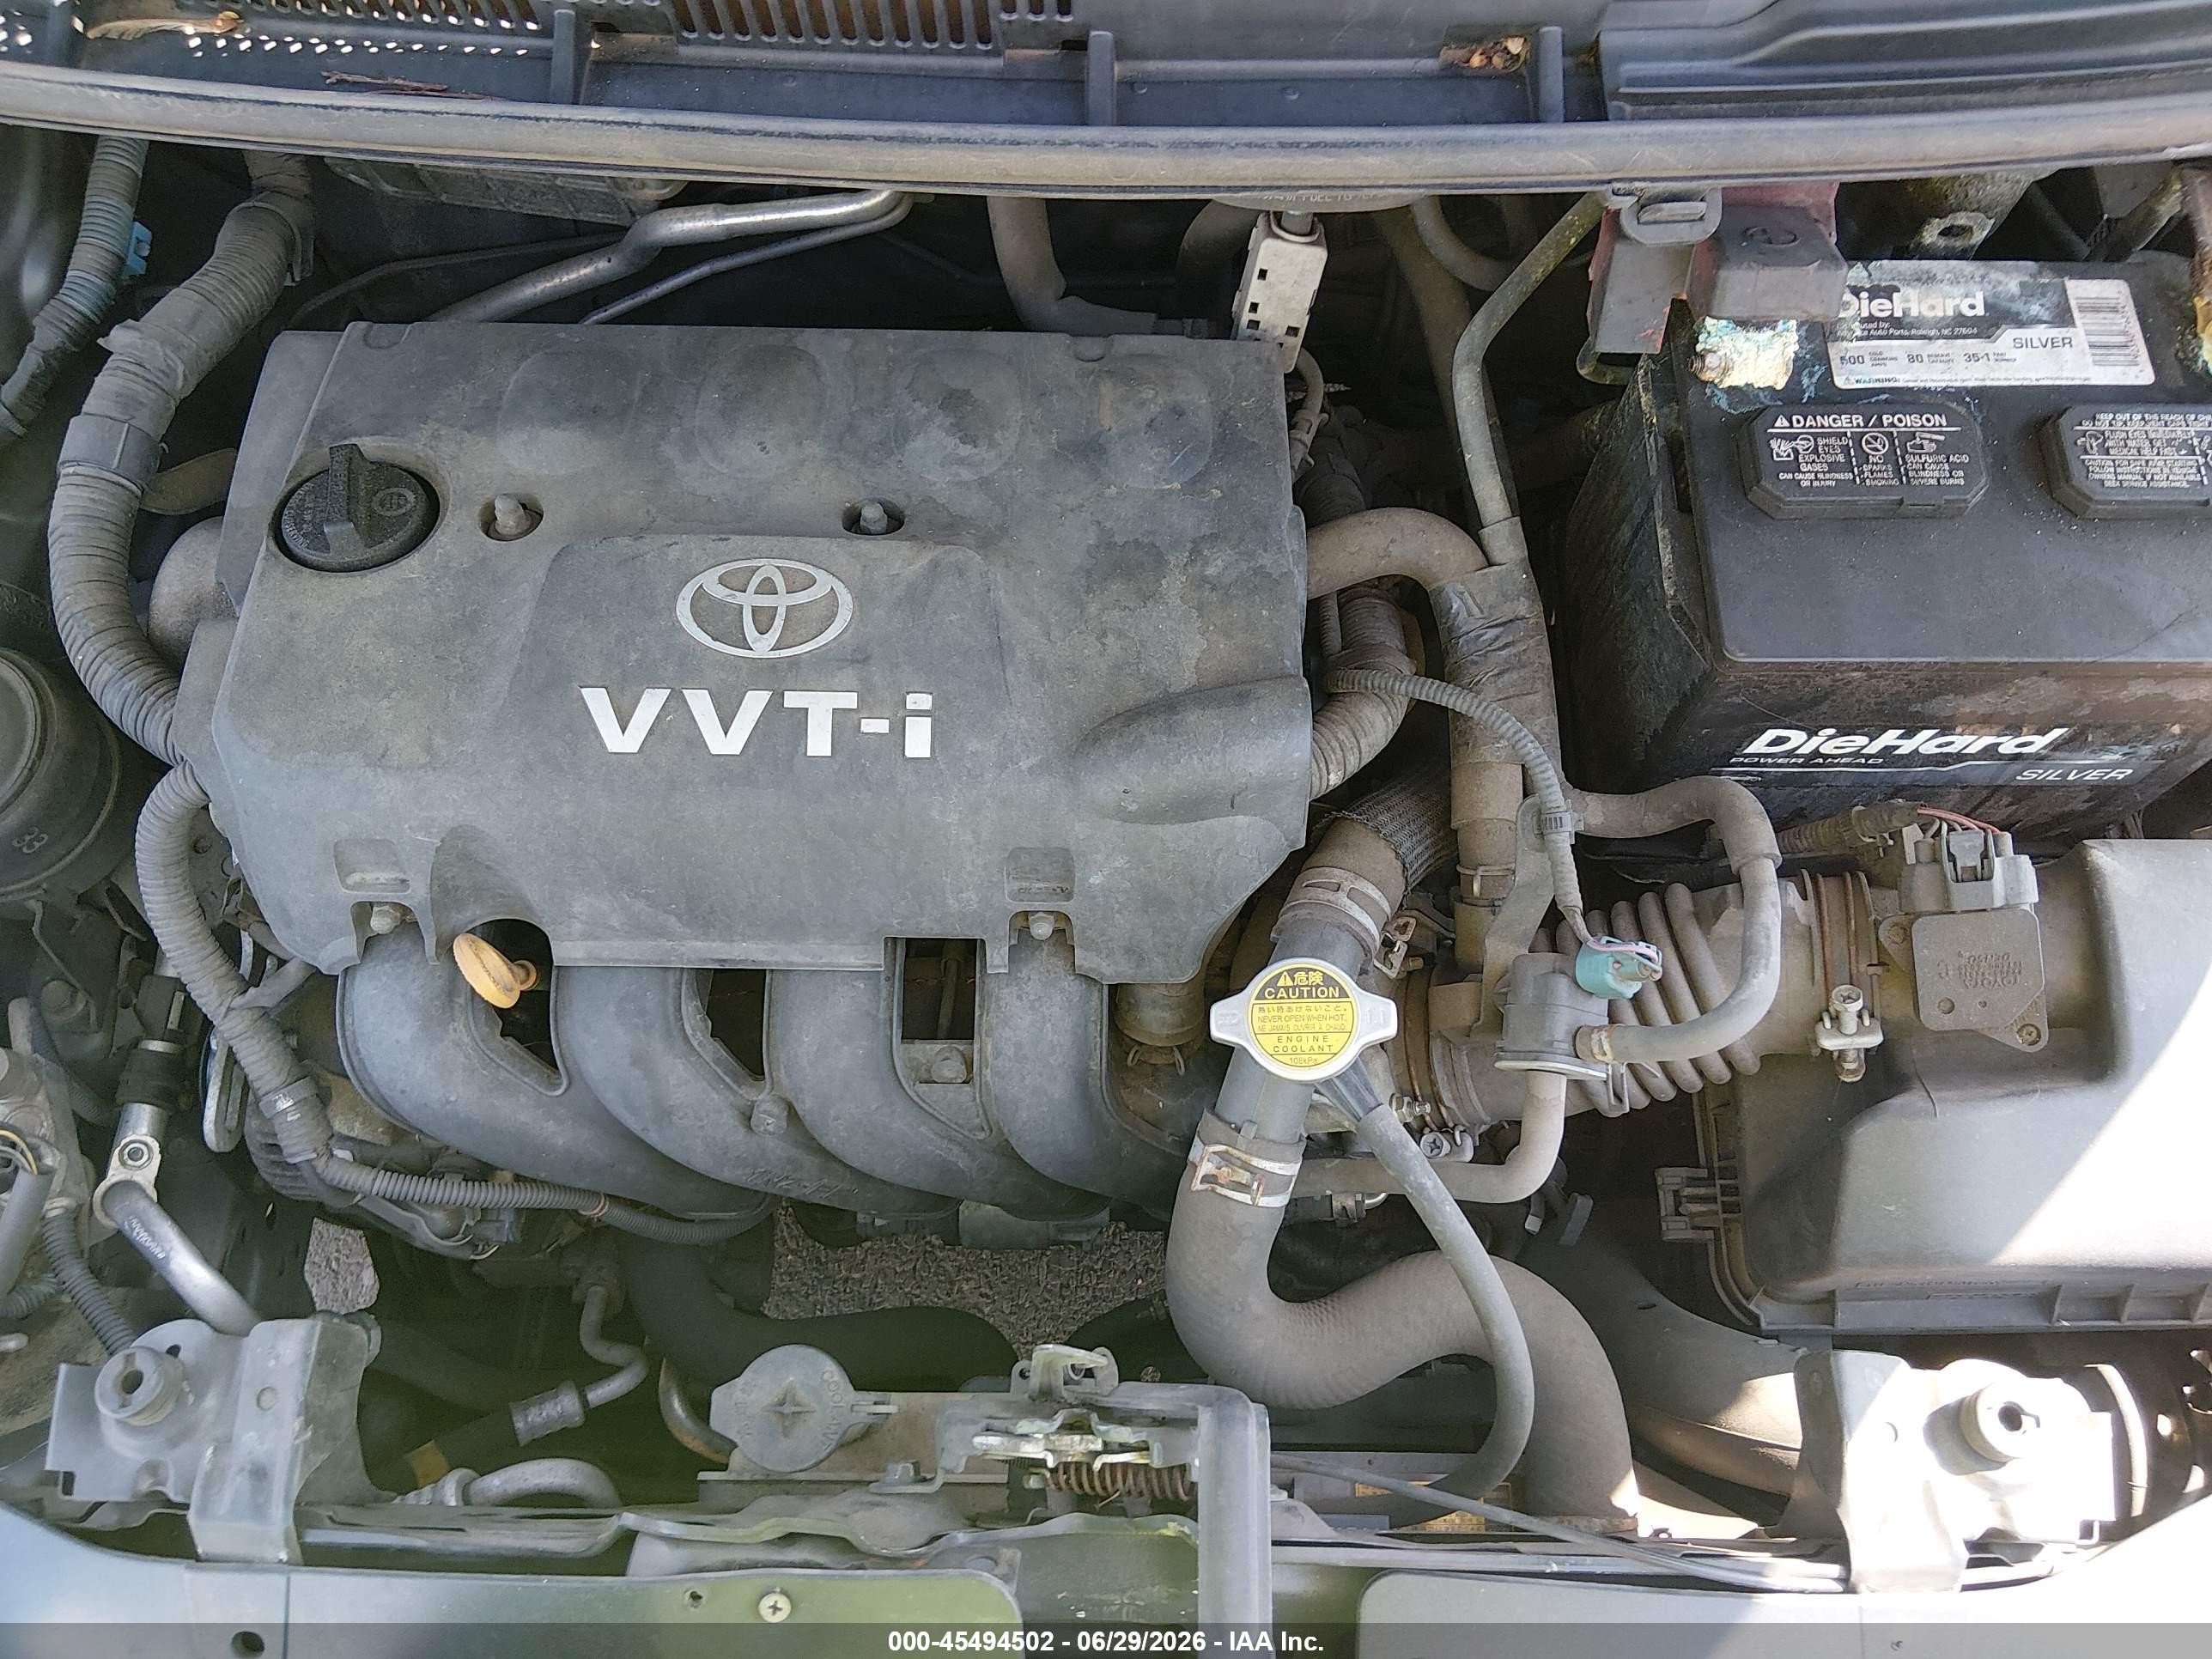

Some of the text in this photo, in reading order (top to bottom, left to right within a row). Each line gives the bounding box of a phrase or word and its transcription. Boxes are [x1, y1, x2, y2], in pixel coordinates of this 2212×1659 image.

[1838, 289, 1985, 318] DieHard
[2013, 336, 2073, 349] SILVER
[1839, 352, 1990, 365] 500 80 35-1
[1792, 415, 1864, 428] DANGER
[1881, 413, 1948, 427] POISON
[2104, 430, 2127, 440] FLUSH
[2128, 430, 2147, 439] EYES
[1817, 436, 1849, 446] SHIELD
[1818, 445, 1841, 454] EYES
[1798, 453, 1846, 463] EXPLOSIVE
[1869, 454, 1884, 464] NO
[1905, 453, 1970, 464] SULFURIC ACID
[1800, 463, 1828, 471] GASES
[1908, 470, 1950, 478] BLINDNESS
[1812, 479, 1836, 488] INJURY
[1939, 477, 1965, 486] BURNS
[579, 687, 933, 758] VVT-i
[1741, 727, 2069, 755] DieHard
[2016, 769, 2135, 781] SILVER
[1293, 971, 1324, 986] 危険
[1964, 975, 2021, 989] TOYOTA
[1264, 987, 1340, 999] CAUTION
[1306, 1013, 1328, 1022] WHEN
[1277, 1035, 1329, 1043] ENGINE
[1273, 1044, 1334, 1053] COOLANT
[1289, 1056, 1318, 1065] 108kPa
